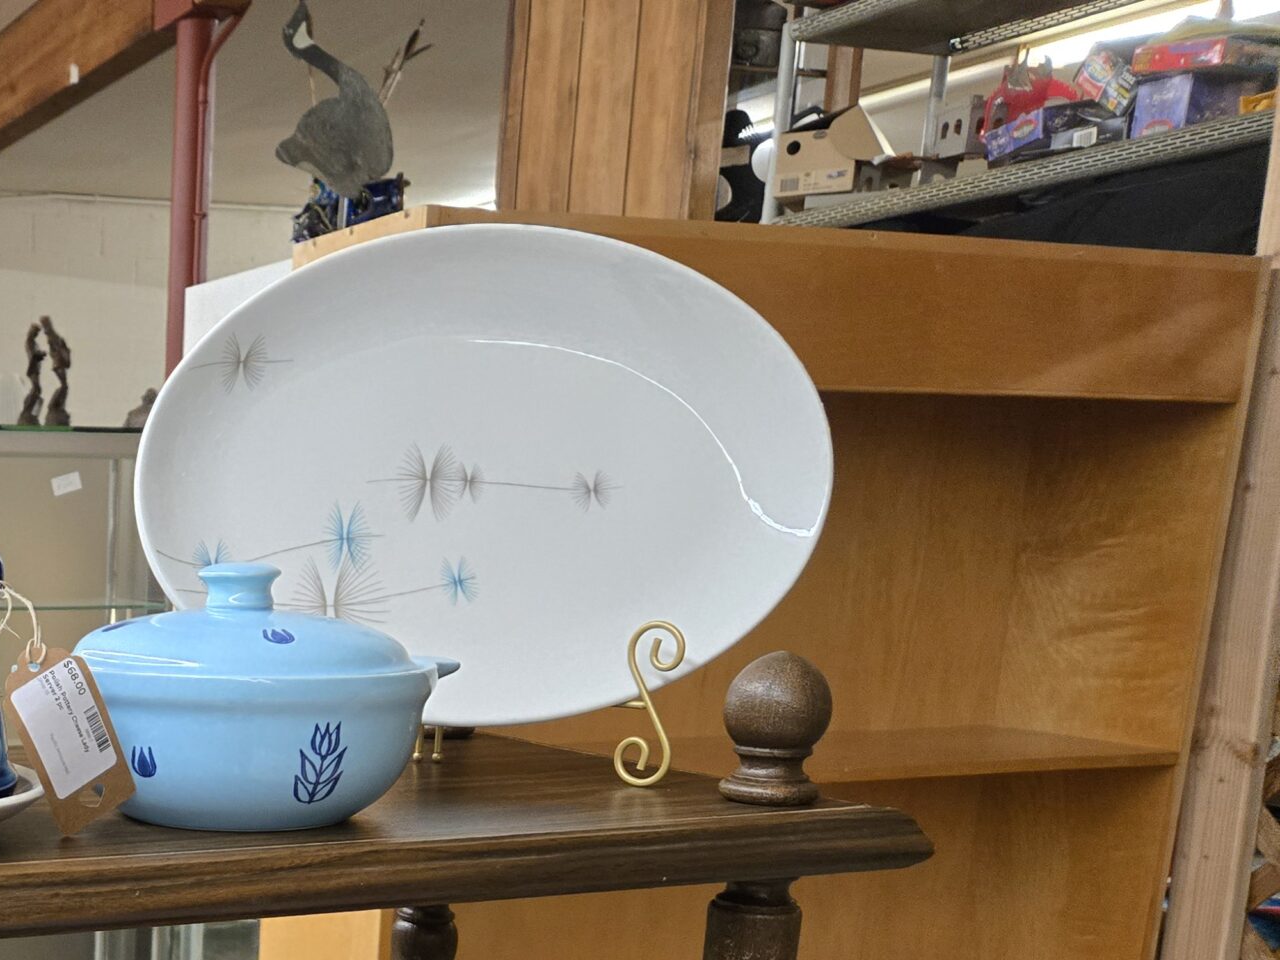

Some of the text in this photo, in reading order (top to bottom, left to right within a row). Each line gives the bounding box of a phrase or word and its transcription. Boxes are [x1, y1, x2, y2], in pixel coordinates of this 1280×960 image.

[42, 674, 57, 696] Server
[56, 701, 64, 711] pc
[63, 660, 86, 696] $68.00
[49, 670, 62, 692] Polish
[61, 691, 73, 715] Pottery
[81, 738, 89, 753] Lady
